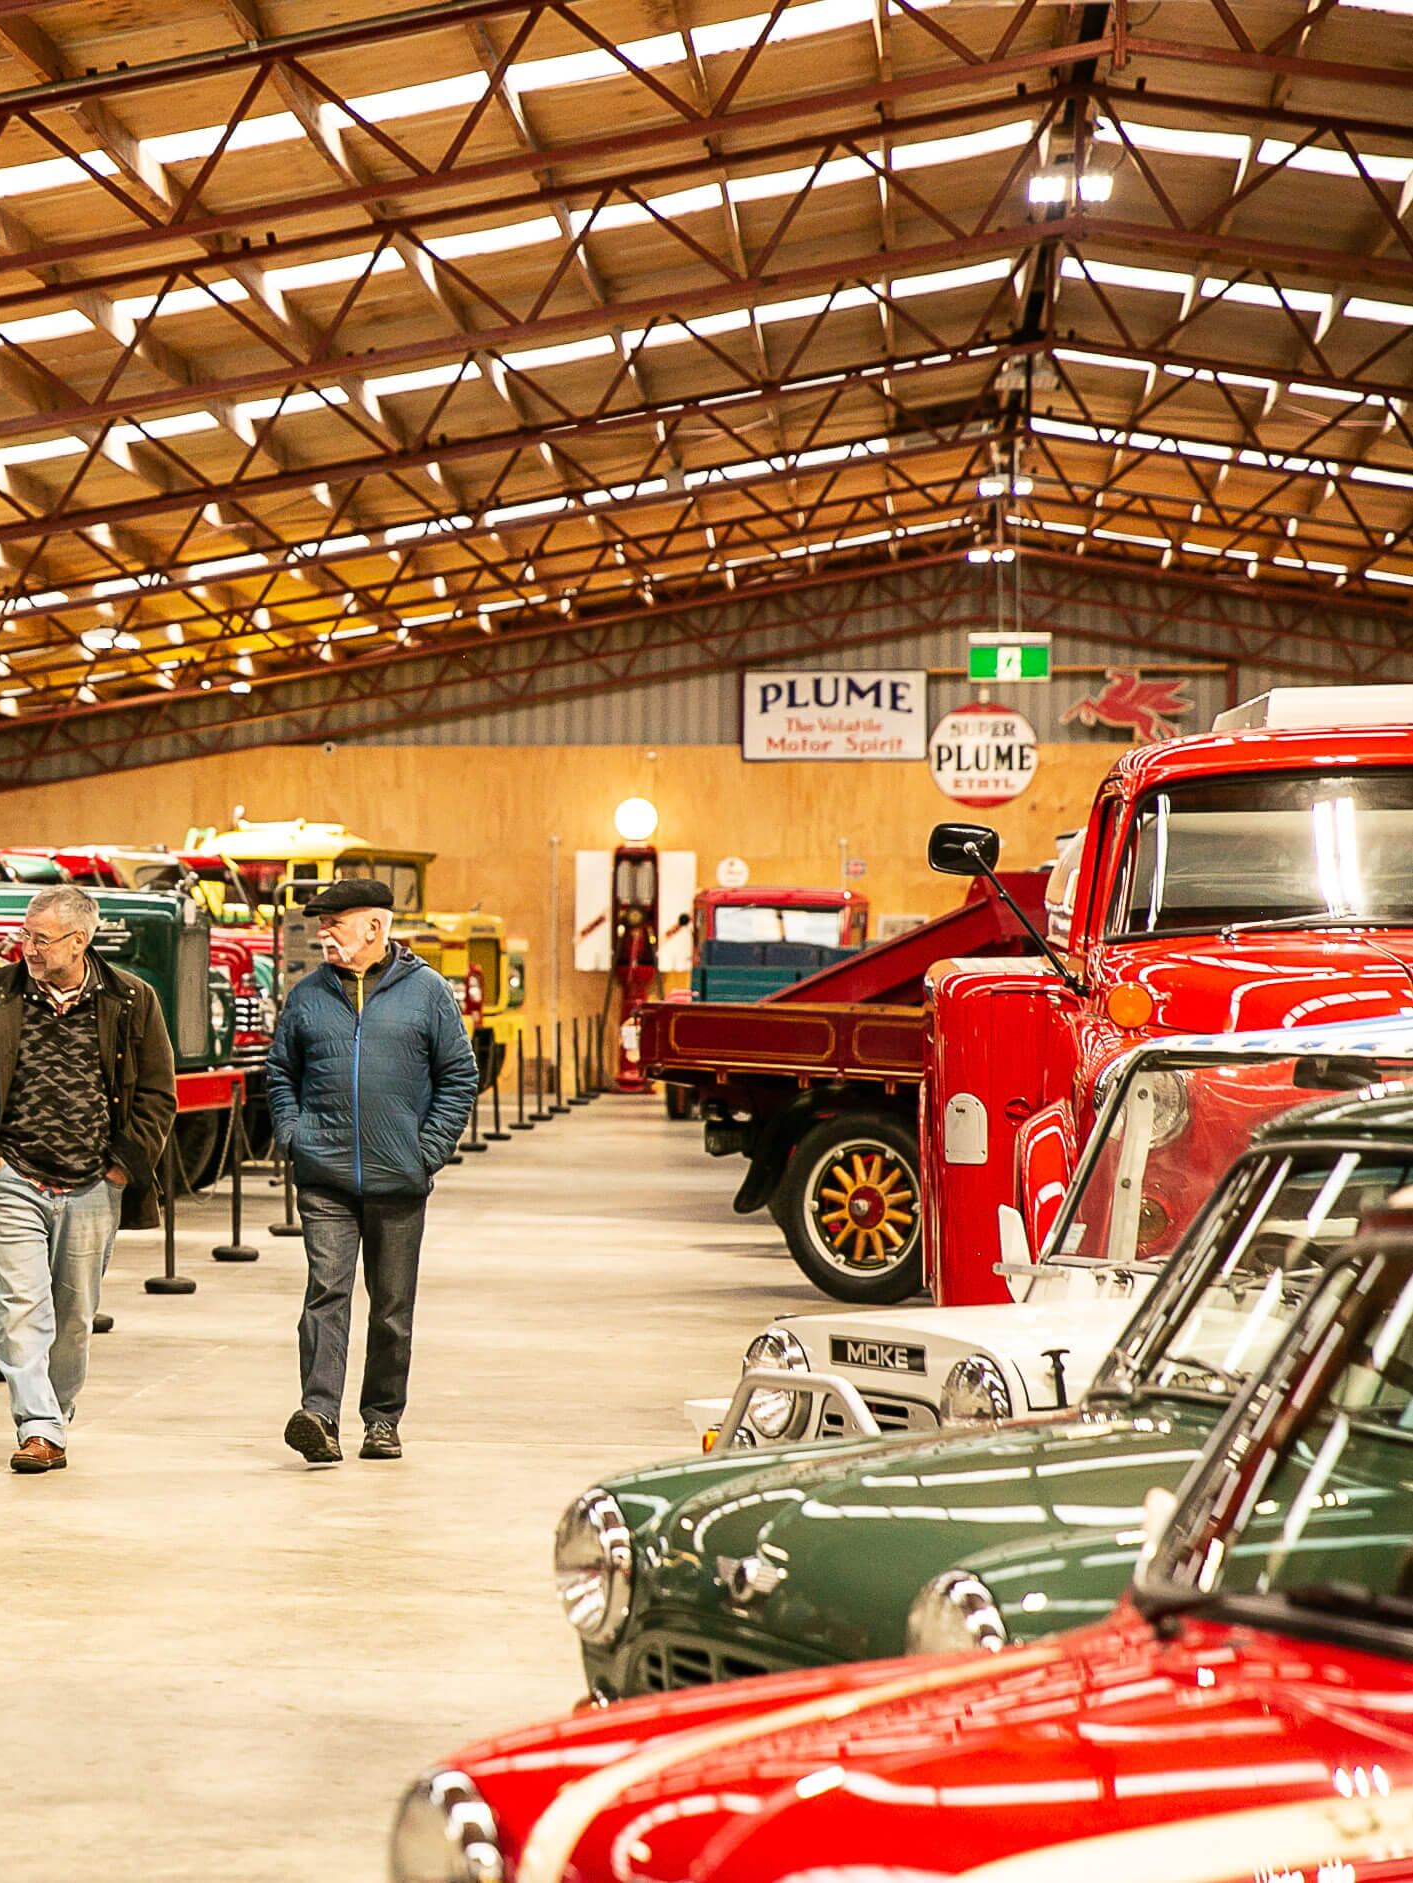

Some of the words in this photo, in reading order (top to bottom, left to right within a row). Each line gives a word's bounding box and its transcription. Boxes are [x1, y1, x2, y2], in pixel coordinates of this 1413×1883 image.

[759, 676, 913, 714] PLUME
[949, 721, 1016, 738] SUPER
[766, 735, 832, 752] Motor
[846, 735, 904, 754] Spirit
[936, 743, 1034, 772] PLUME
[847, 1341, 909, 1370] MOKE
